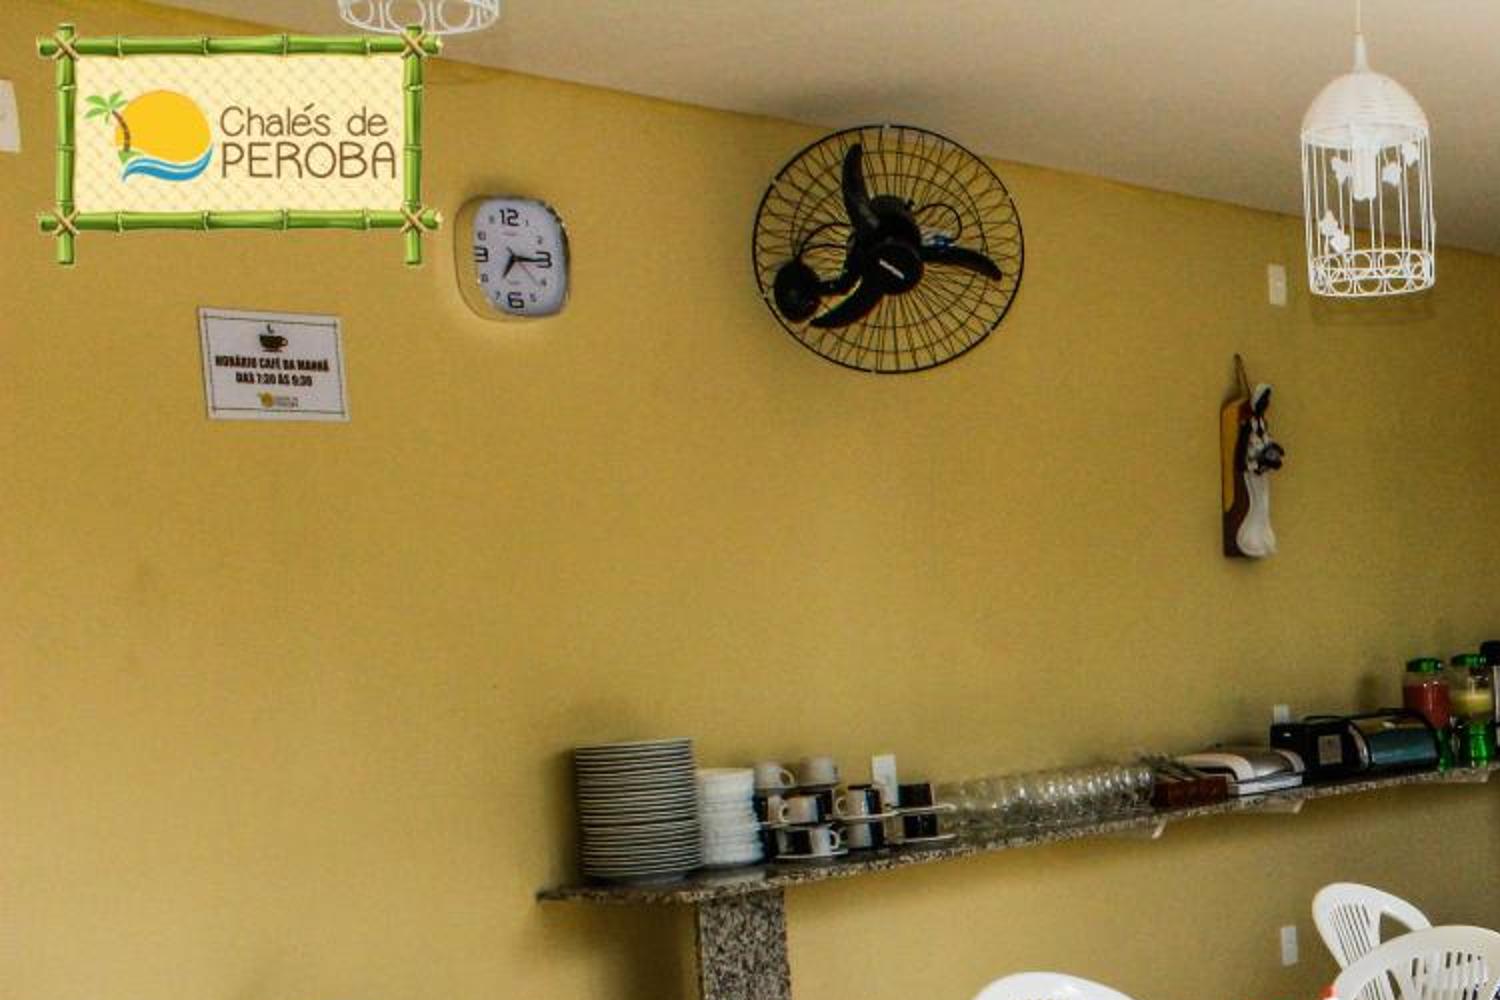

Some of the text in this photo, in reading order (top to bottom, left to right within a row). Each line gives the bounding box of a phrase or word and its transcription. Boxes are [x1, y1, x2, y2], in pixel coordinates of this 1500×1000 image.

[499, 208, 520, 226] 12
[536, 251, 552, 269] 3
[508, 291, 525, 309] 6
